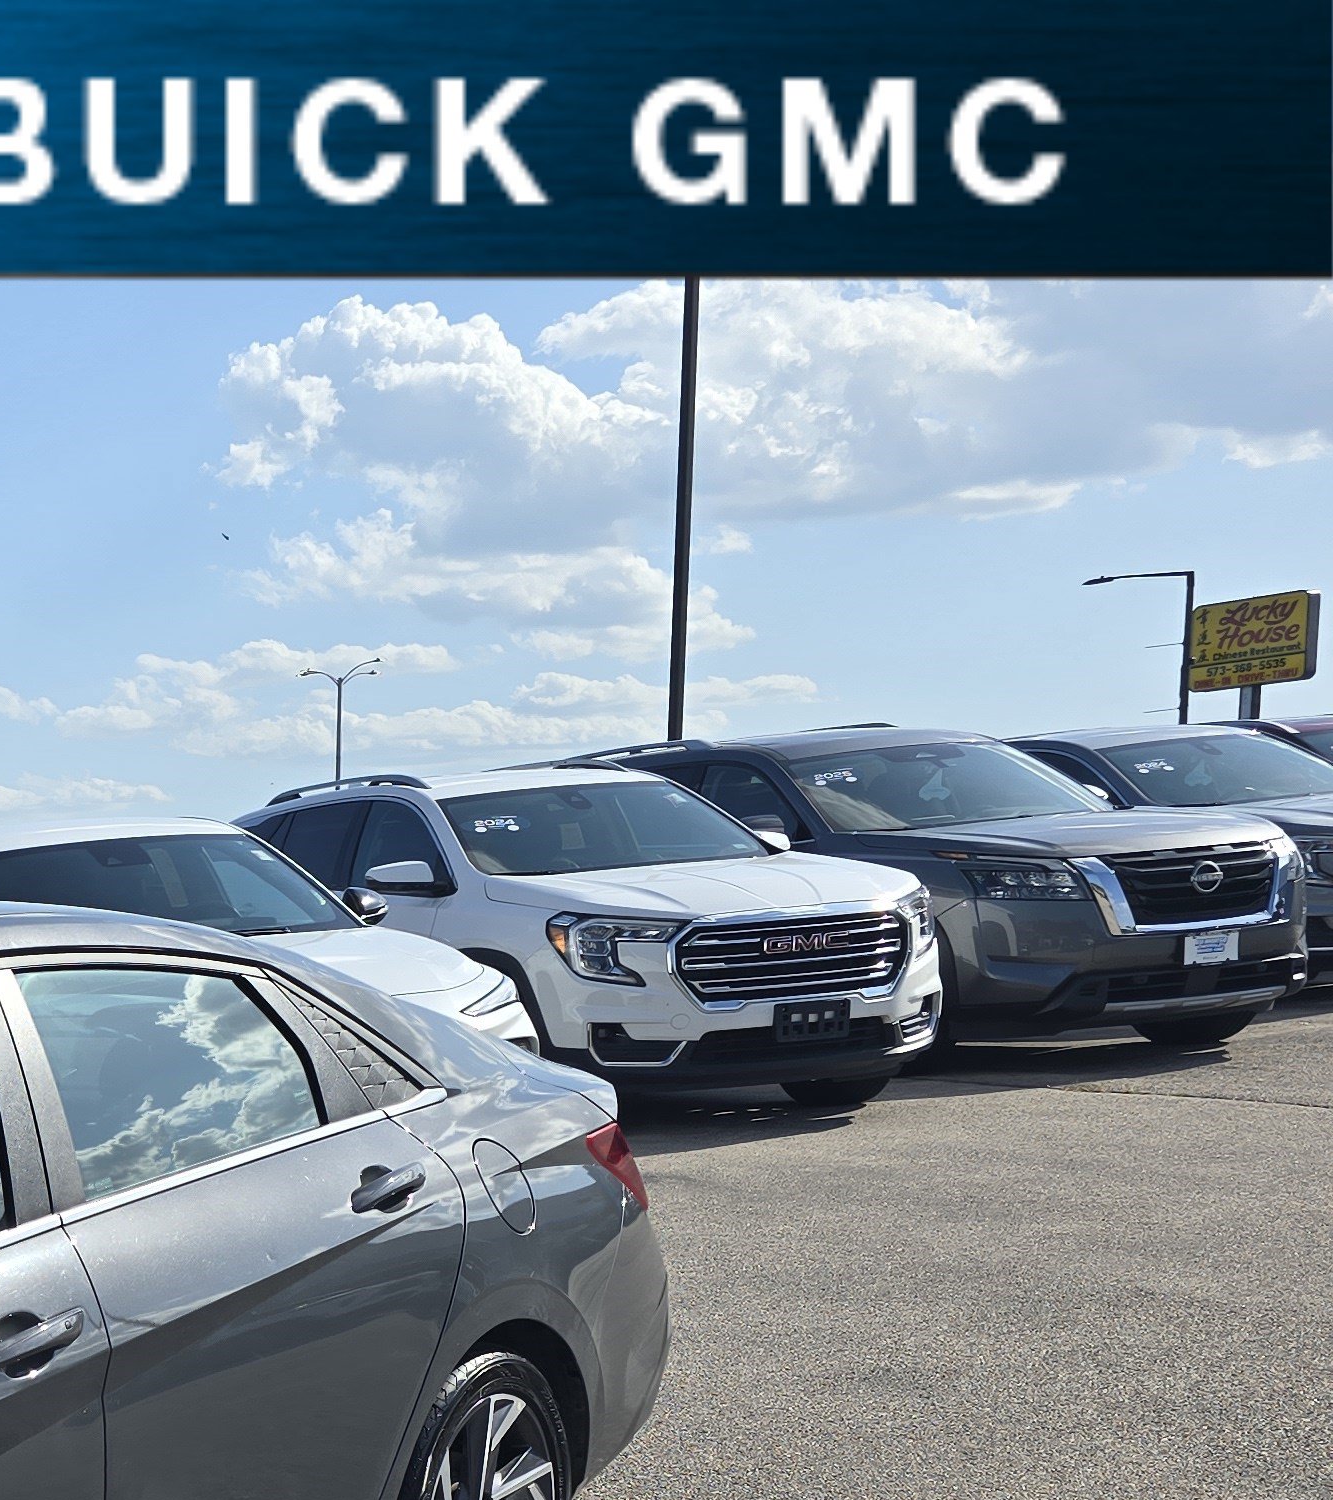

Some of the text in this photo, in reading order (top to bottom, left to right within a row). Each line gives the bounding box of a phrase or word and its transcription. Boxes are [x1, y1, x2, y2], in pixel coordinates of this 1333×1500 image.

[1219, 599, 1299, 627] Lucky
[1216, 624, 1300, 650] House
[1213, 642, 1302, 661] Chinese Restaurant
[1238, 667, 1298, 684] DRIVE-THRU
[763, 931, 849, 955] GMC
